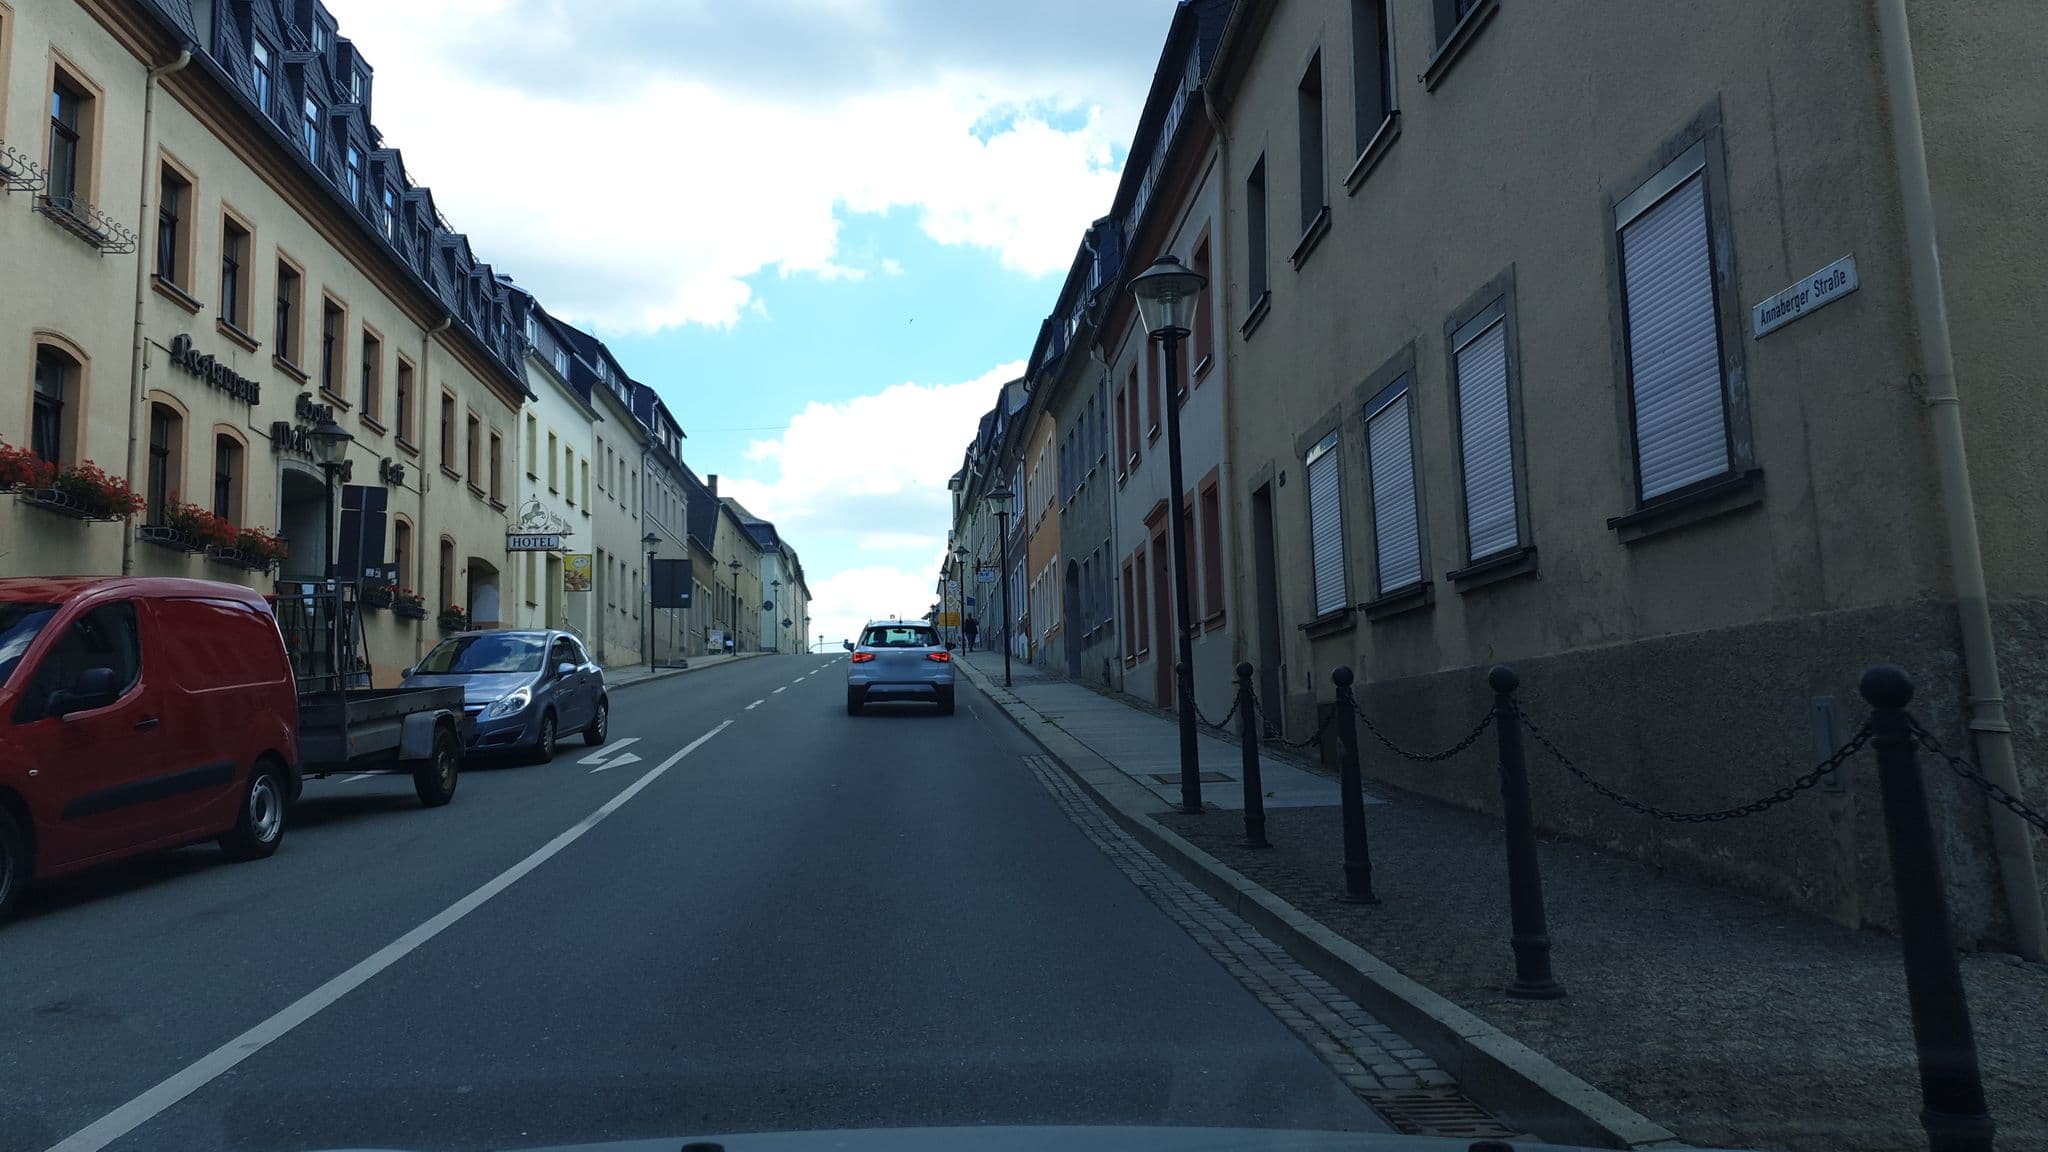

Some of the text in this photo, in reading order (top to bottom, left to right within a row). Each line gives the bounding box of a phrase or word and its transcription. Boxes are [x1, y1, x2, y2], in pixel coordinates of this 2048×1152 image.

[1760, 269, 1847, 327] Annaberger Straße
[171, 333, 260, 406] Restaurant
[512, 537, 555, 548] HOTEL
